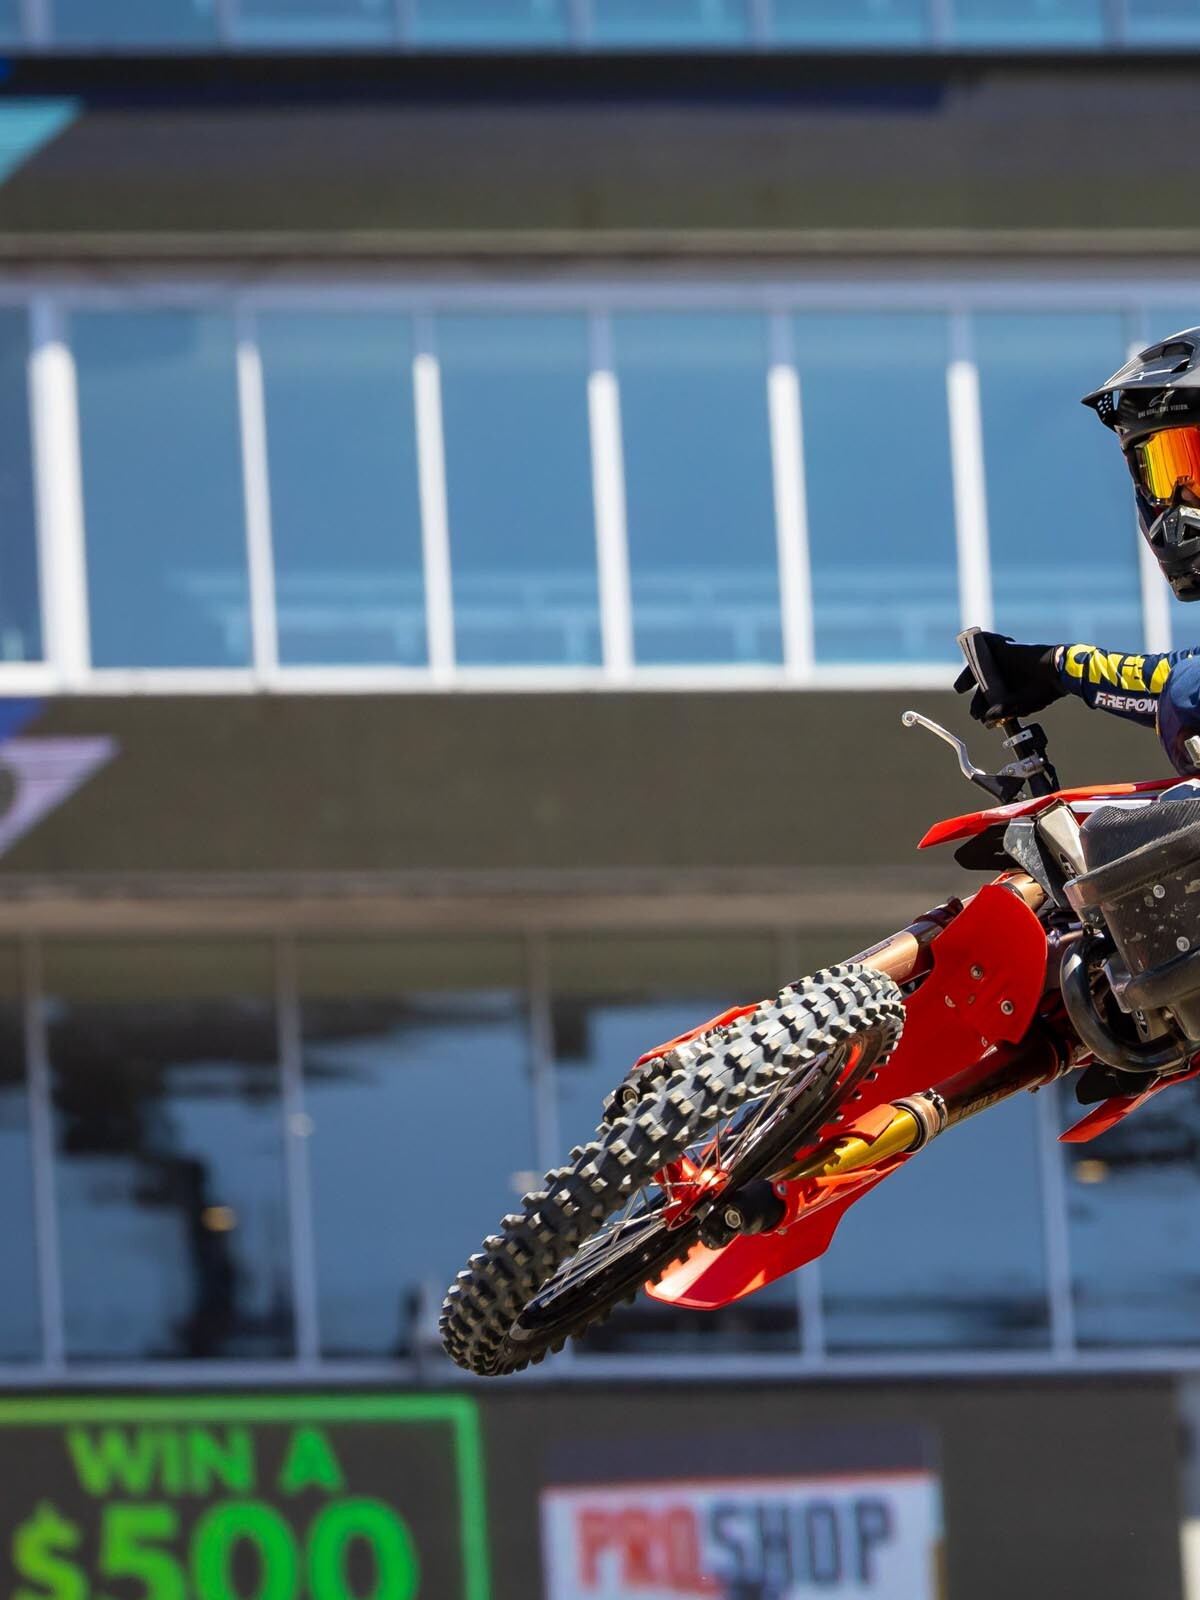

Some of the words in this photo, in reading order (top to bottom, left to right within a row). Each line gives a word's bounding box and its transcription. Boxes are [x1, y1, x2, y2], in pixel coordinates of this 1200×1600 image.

[68, 1426, 255, 1496] WIN
[279, 1425, 346, 1493] A
[12, 1499, 419, 1600] $500
